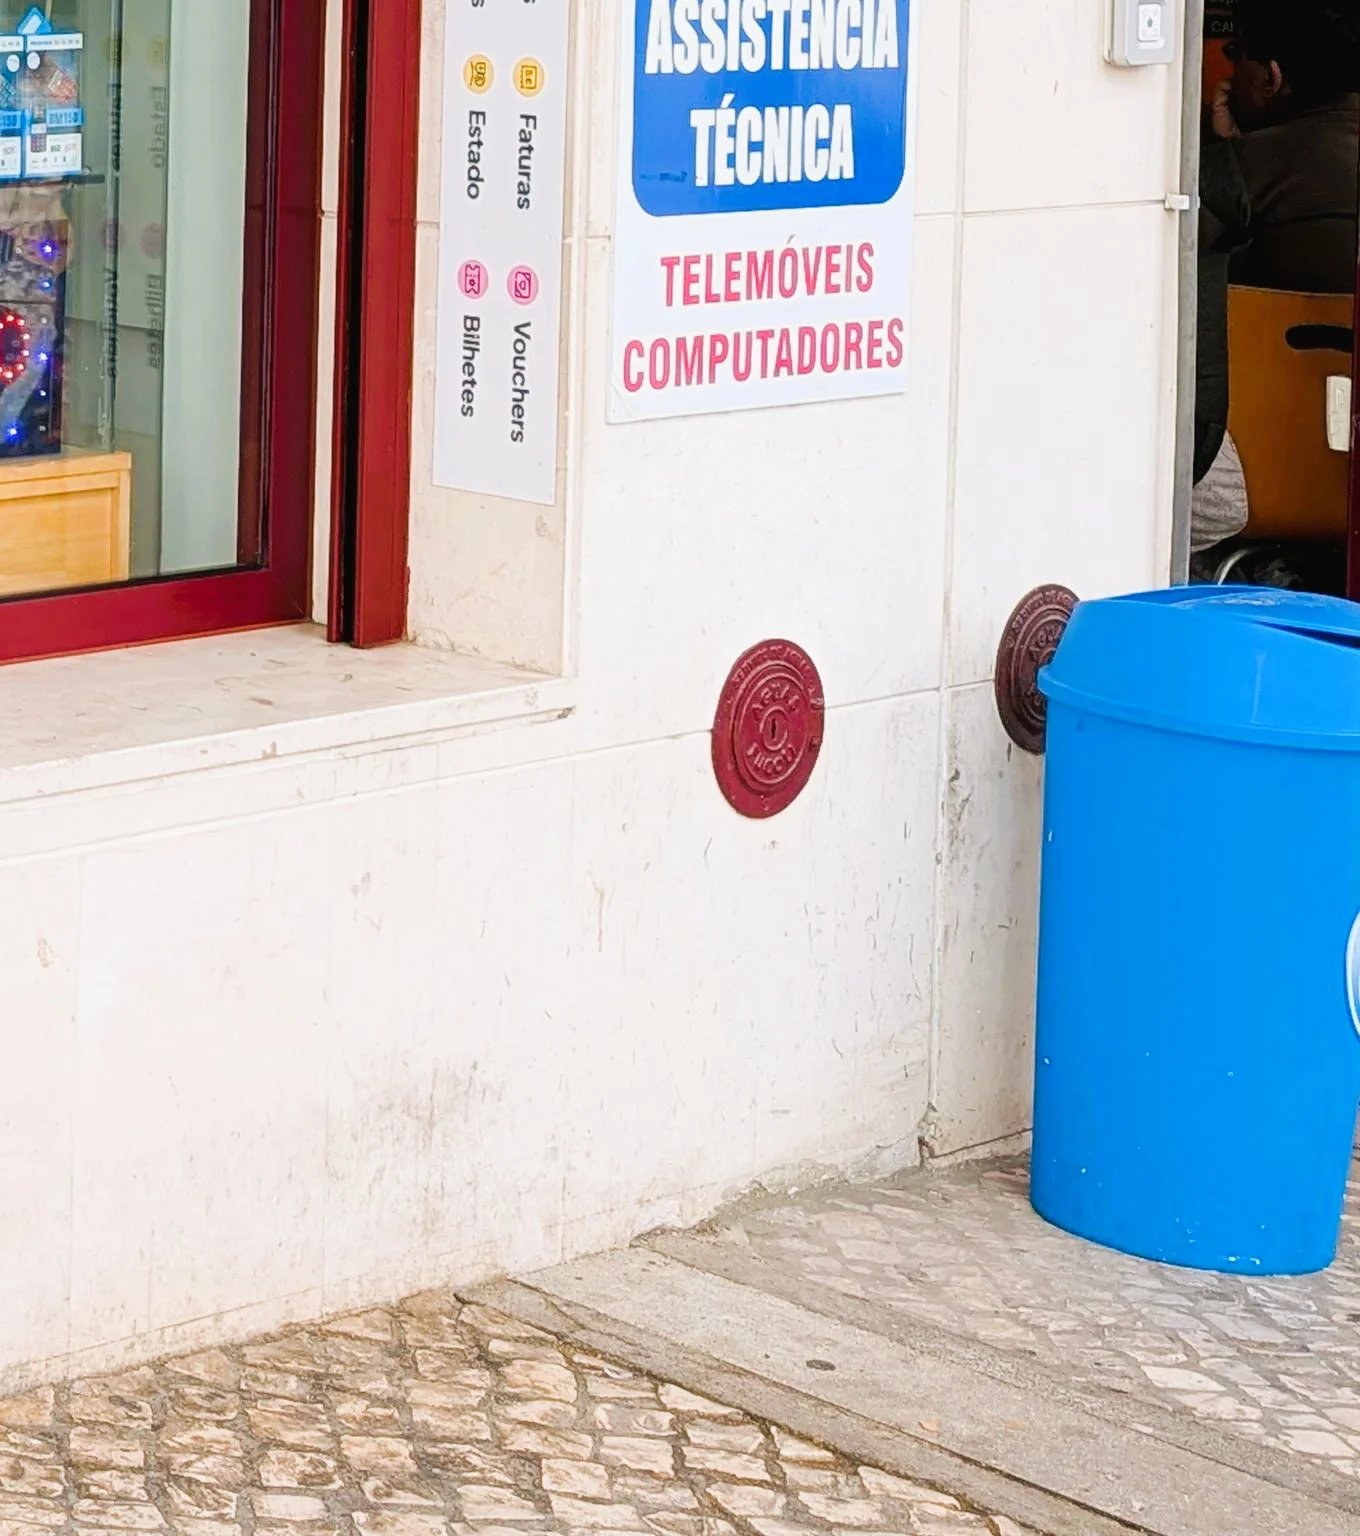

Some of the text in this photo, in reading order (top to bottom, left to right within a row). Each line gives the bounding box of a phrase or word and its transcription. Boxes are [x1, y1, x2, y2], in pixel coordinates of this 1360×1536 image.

[466, 109, 486, 200] Estado
[516, 113, 537, 210] Faturas
[690, 94, 855, 187] TÉCNICA
[660, 235, 875, 307] TELEMÓVEIS
[461, 314, 480, 418] Bilhetes
[510, 321, 531, 443] Vouchers
[623, 317, 904, 392] COMPUTADORES
